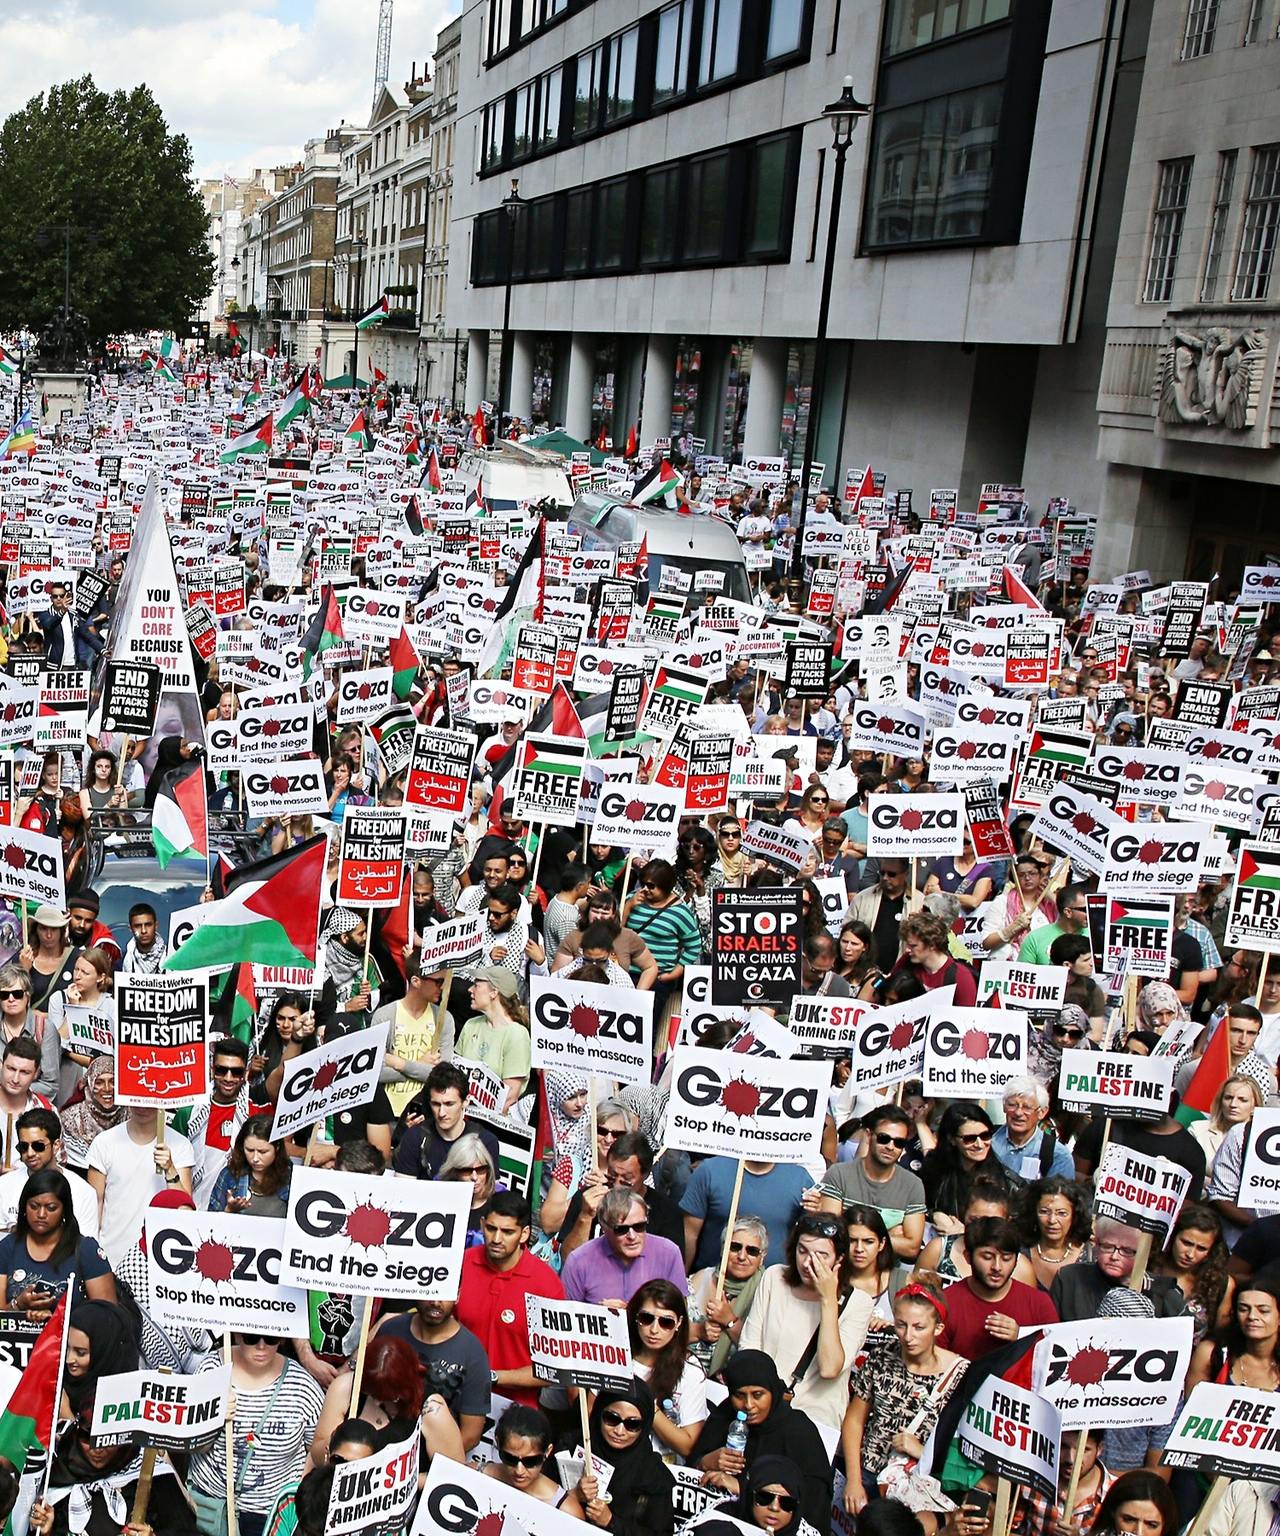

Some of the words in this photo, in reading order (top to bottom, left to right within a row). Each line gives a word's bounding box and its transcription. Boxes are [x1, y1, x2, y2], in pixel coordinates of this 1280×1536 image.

[147, 589, 170, 602] YOU
[141, 607, 175, 619] DON'T
[142, 622, 172, 636] CARE
[131, 640, 183, 653] BECAUSE
[1010, 633, 1048, 646] FREEDOM
[795, 649, 825, 662] END
[1007, 648, 1048, 658] PALESTINE
[791, 670, 826, 678] ATTACKS
[791, 678, 803, 686] ON
[805, 678, 824, 686] GAZA
[1185, 686, 1220, 704] END
[746, 764, 764, 773] FREE
[523, 771, 578, 798] FREE
[730, 773, 781, 785] PALESTINE
[518, 791, 576, 808] PALESTINE
[596, 822, 616, 835] Stop
[617, 825, 633, 836] the
[635, 828, 671, 838] massacre
[1105, 872, 1128, 882] End
[1132, 872, 1152, 881] the
[1157, 871, 1193, 884] siege
[718, 912, 798, 934] STOP
[718, 936, 797, 951] ISRAEL'S
[1109, 925, 1167, 949] FREE
[717, 953, 746, 964] WAR
[750, 953, 797, 964] CRIMES
[129, 977, 165, 987] Socialist
[167, 976, 193, 987] Worker
[718, 967, 736, 981] IN
[742, 966, 796, 982] GAZA
[125, 988, 197, 1013] FREEDOM
[157, 1013, 169, 1023] for
[121, 1020, 202, 1046] PALESTINE
[127, 1048, 196, 1071] لفلسطين
[1097, 1061, 1132, 1077] FREE
[137, 1072, 192, 1094] الحرية
[1066, 1074, 1163, 1100] PALESTINE
[276, 1106, 303, 1129] End
[307, 1096, 328, 1115] the
[330, 1081, 369, 1102] siege
[674, 1116, 708, 1133] Stop
[713, 1120, 735, 1136] the
[740, 1126, 812, 1142] massacre
[290, 1249, 332, 1272] End
[340, 1256, 378, 1278] the
[385, 1260, 448, 1286] siege
[541, 1309, 572, 1332] END
[576, 1312, 608, 1336] THE
[533, 1334, 626, 1366] OCCUPATION
[140, 1382, 187, 1403] FREE
[101, 1396, 220, 1424] PALESTINE
[1225, 1399, 1275, 1425] FREE
